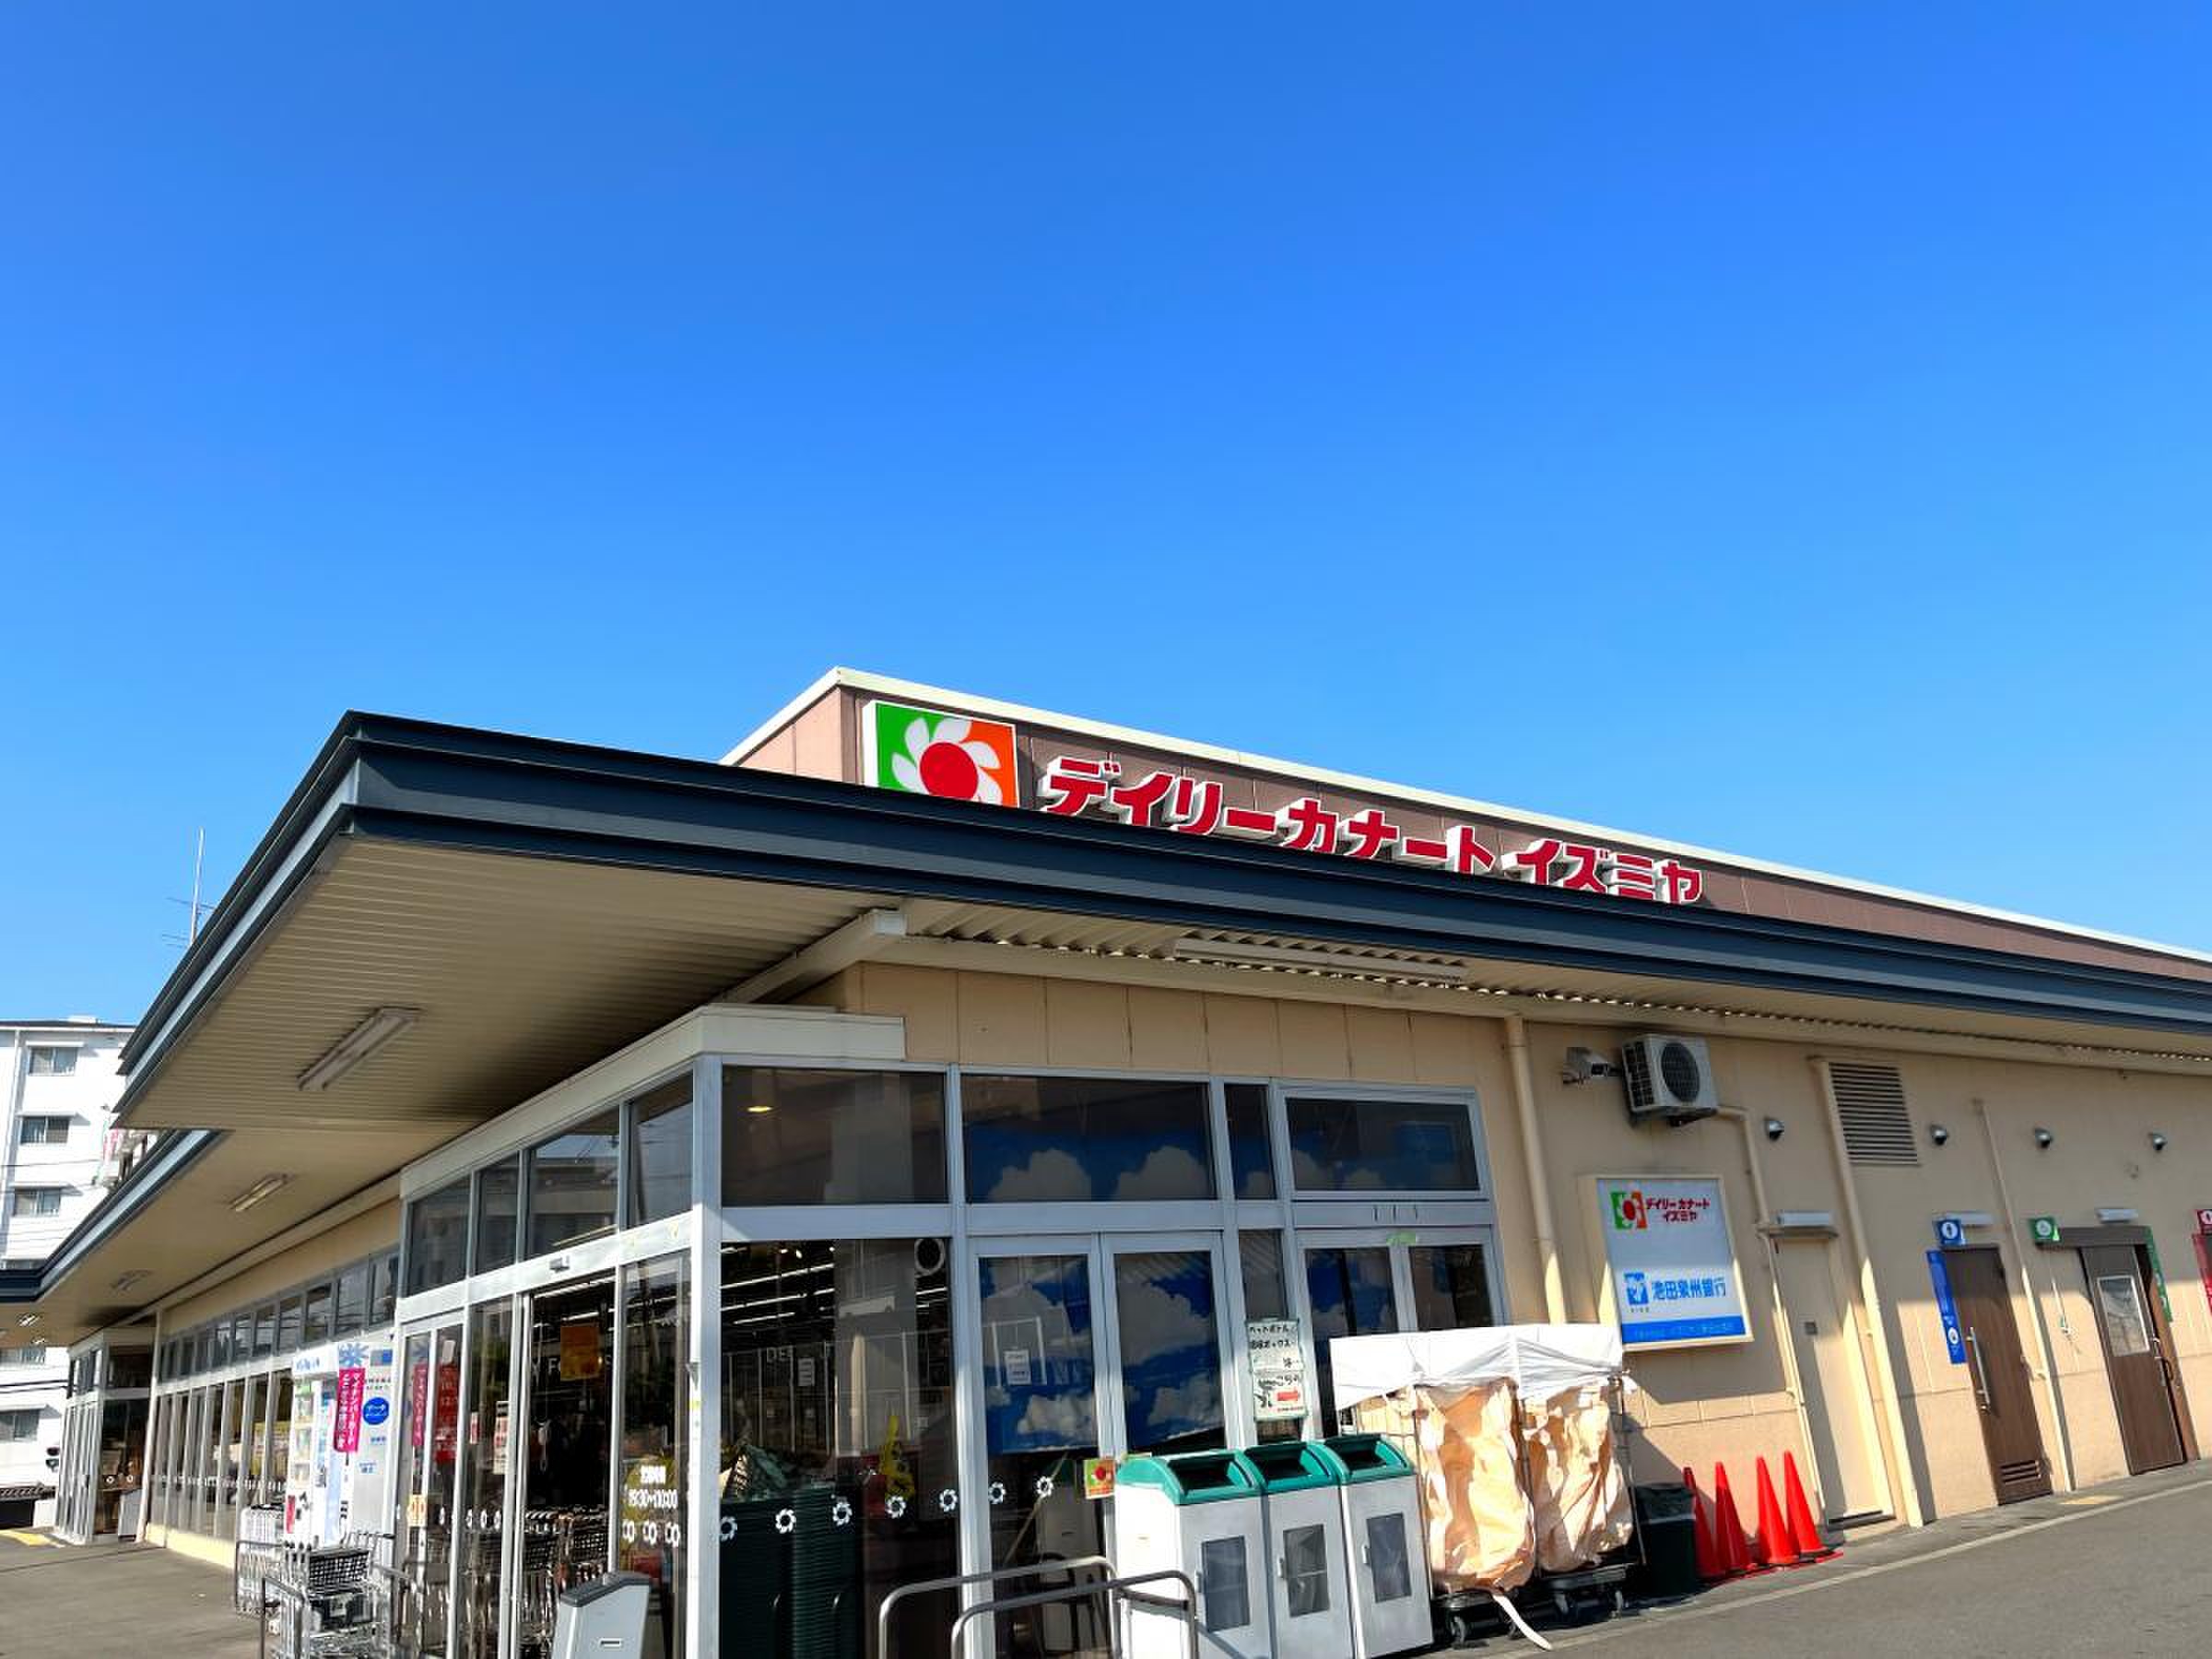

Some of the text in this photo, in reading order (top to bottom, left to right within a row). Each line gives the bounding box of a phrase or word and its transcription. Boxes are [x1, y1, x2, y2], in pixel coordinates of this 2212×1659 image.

[1041, 755, 1703, 904] デイリーカナート イズミヤ
[1663, 1209, 1698, 1222] イズミヤ
